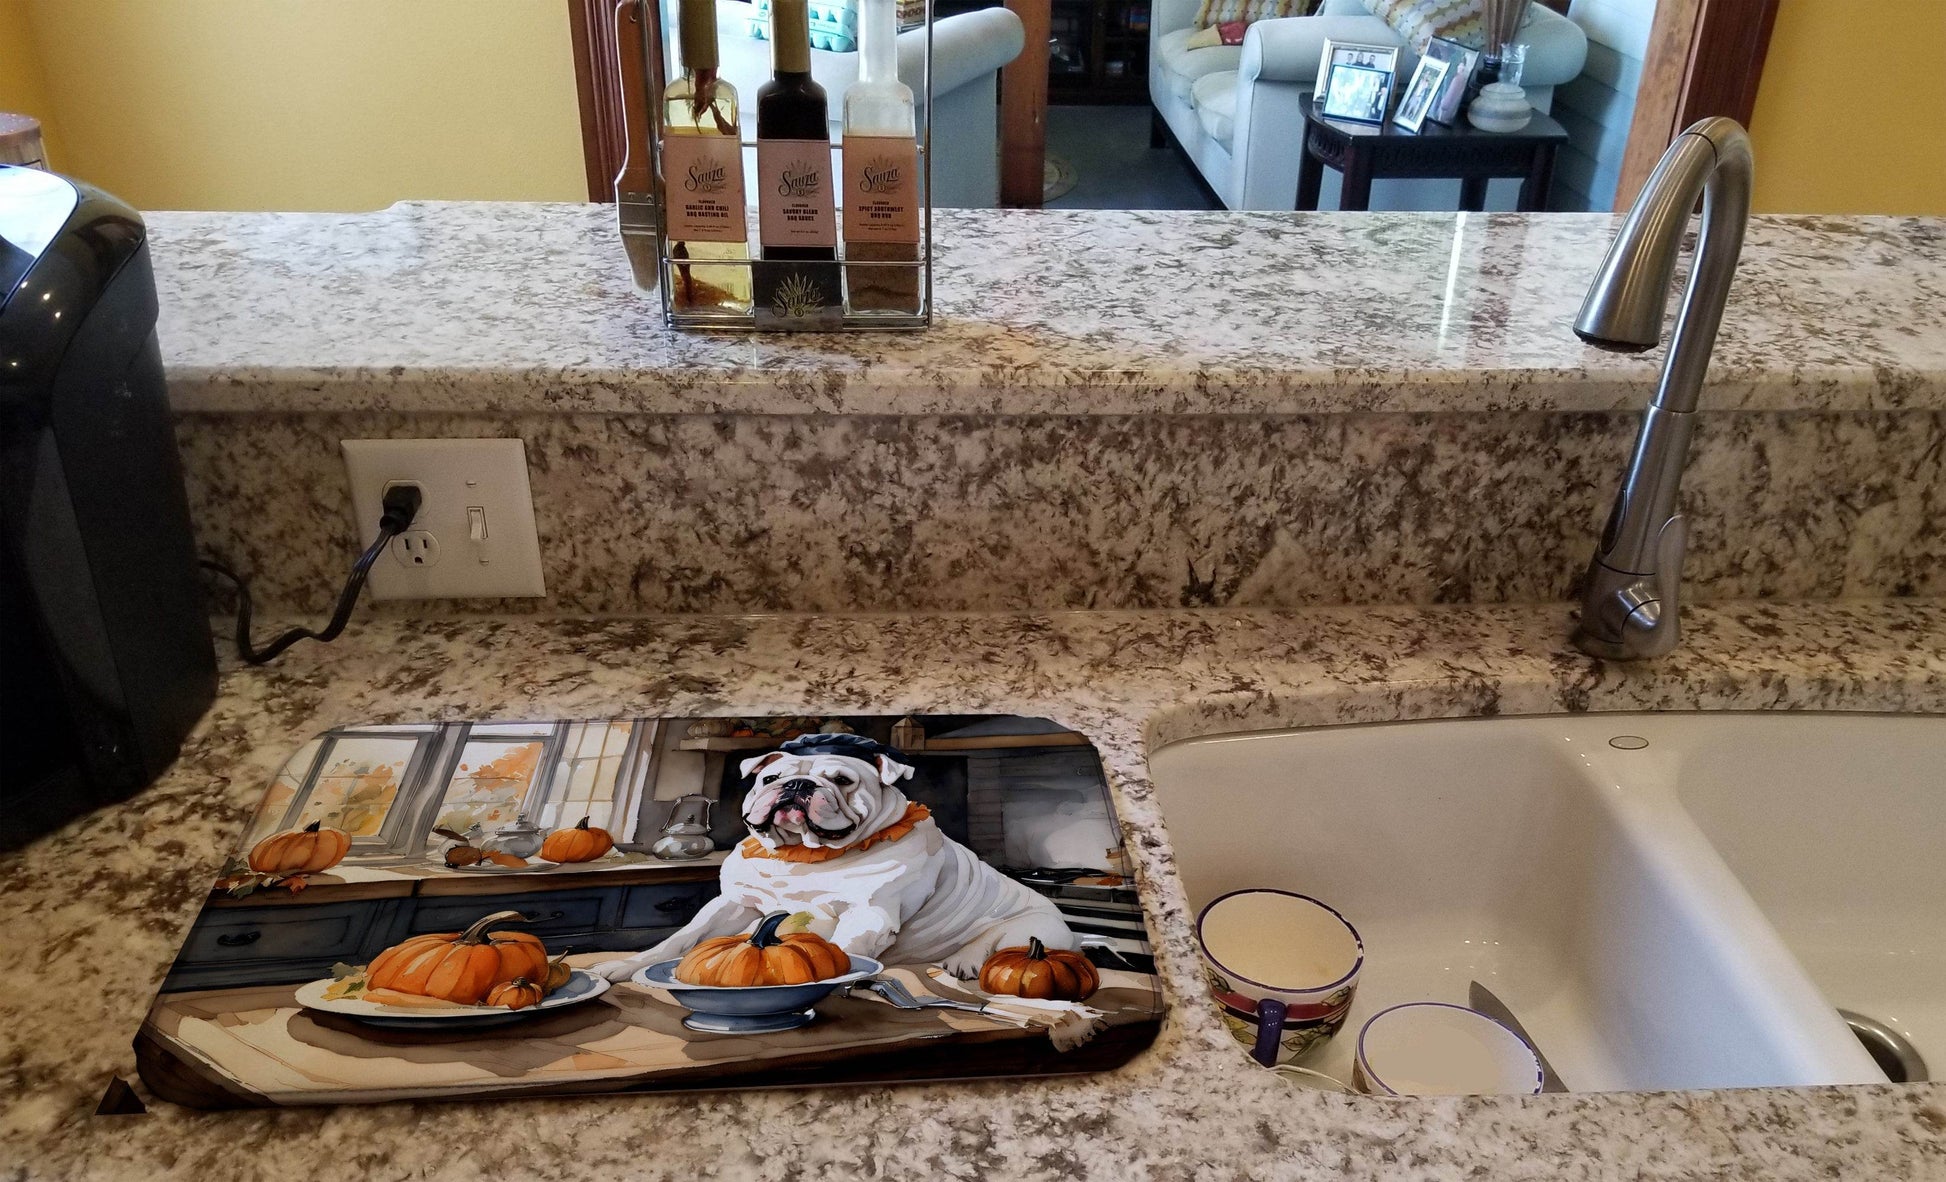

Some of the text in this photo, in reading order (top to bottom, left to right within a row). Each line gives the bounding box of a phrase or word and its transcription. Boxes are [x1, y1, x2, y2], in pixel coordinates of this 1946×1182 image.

[685, 166, 726, 192] Sauza
[778, 171, 819, 197] Sauza
[860, 167, 900, 193] Sauza
[771, 288, 821, 318] Sauza
